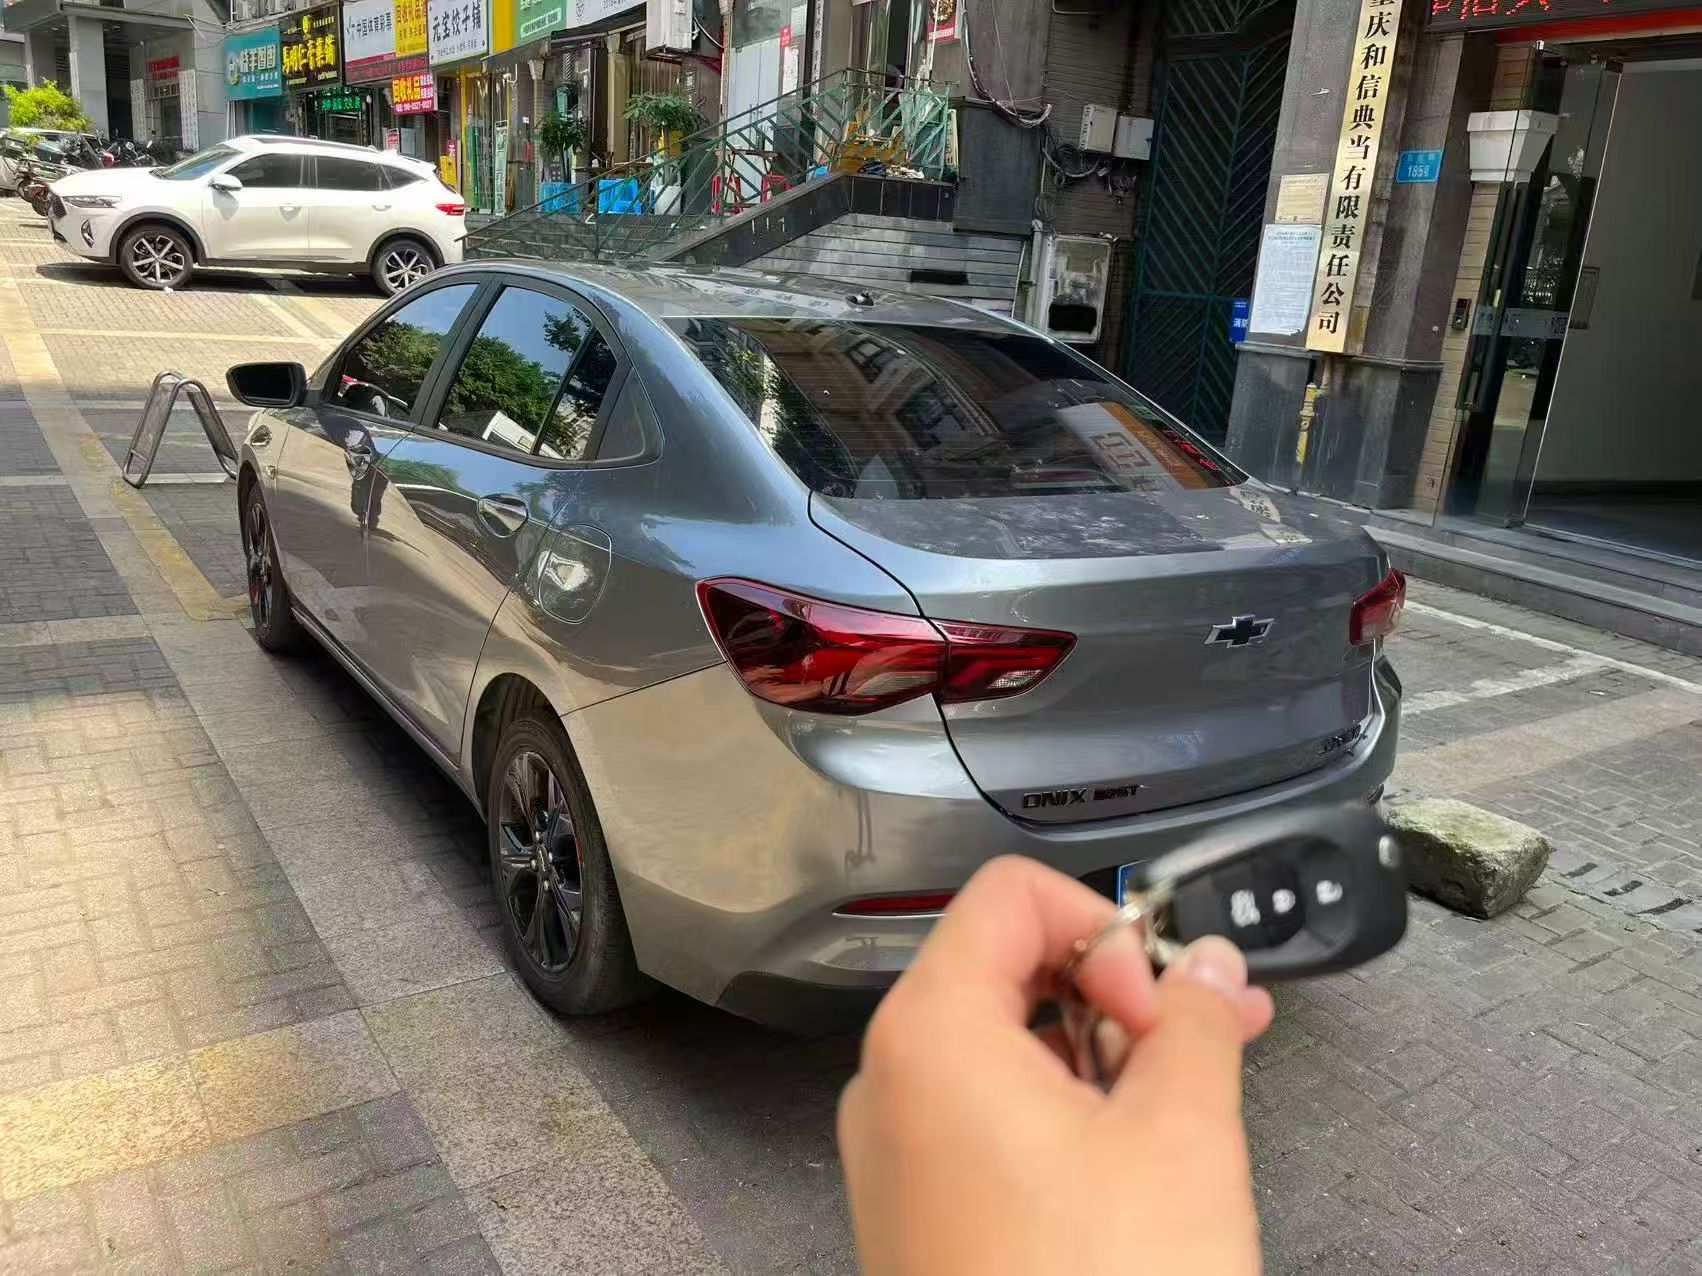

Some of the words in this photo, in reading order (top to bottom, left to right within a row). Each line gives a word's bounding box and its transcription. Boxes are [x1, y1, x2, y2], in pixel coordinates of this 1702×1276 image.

[432, 0, 481, 42] 元宝饺子铺
[1023, 788, 1088, 808] ONIX
